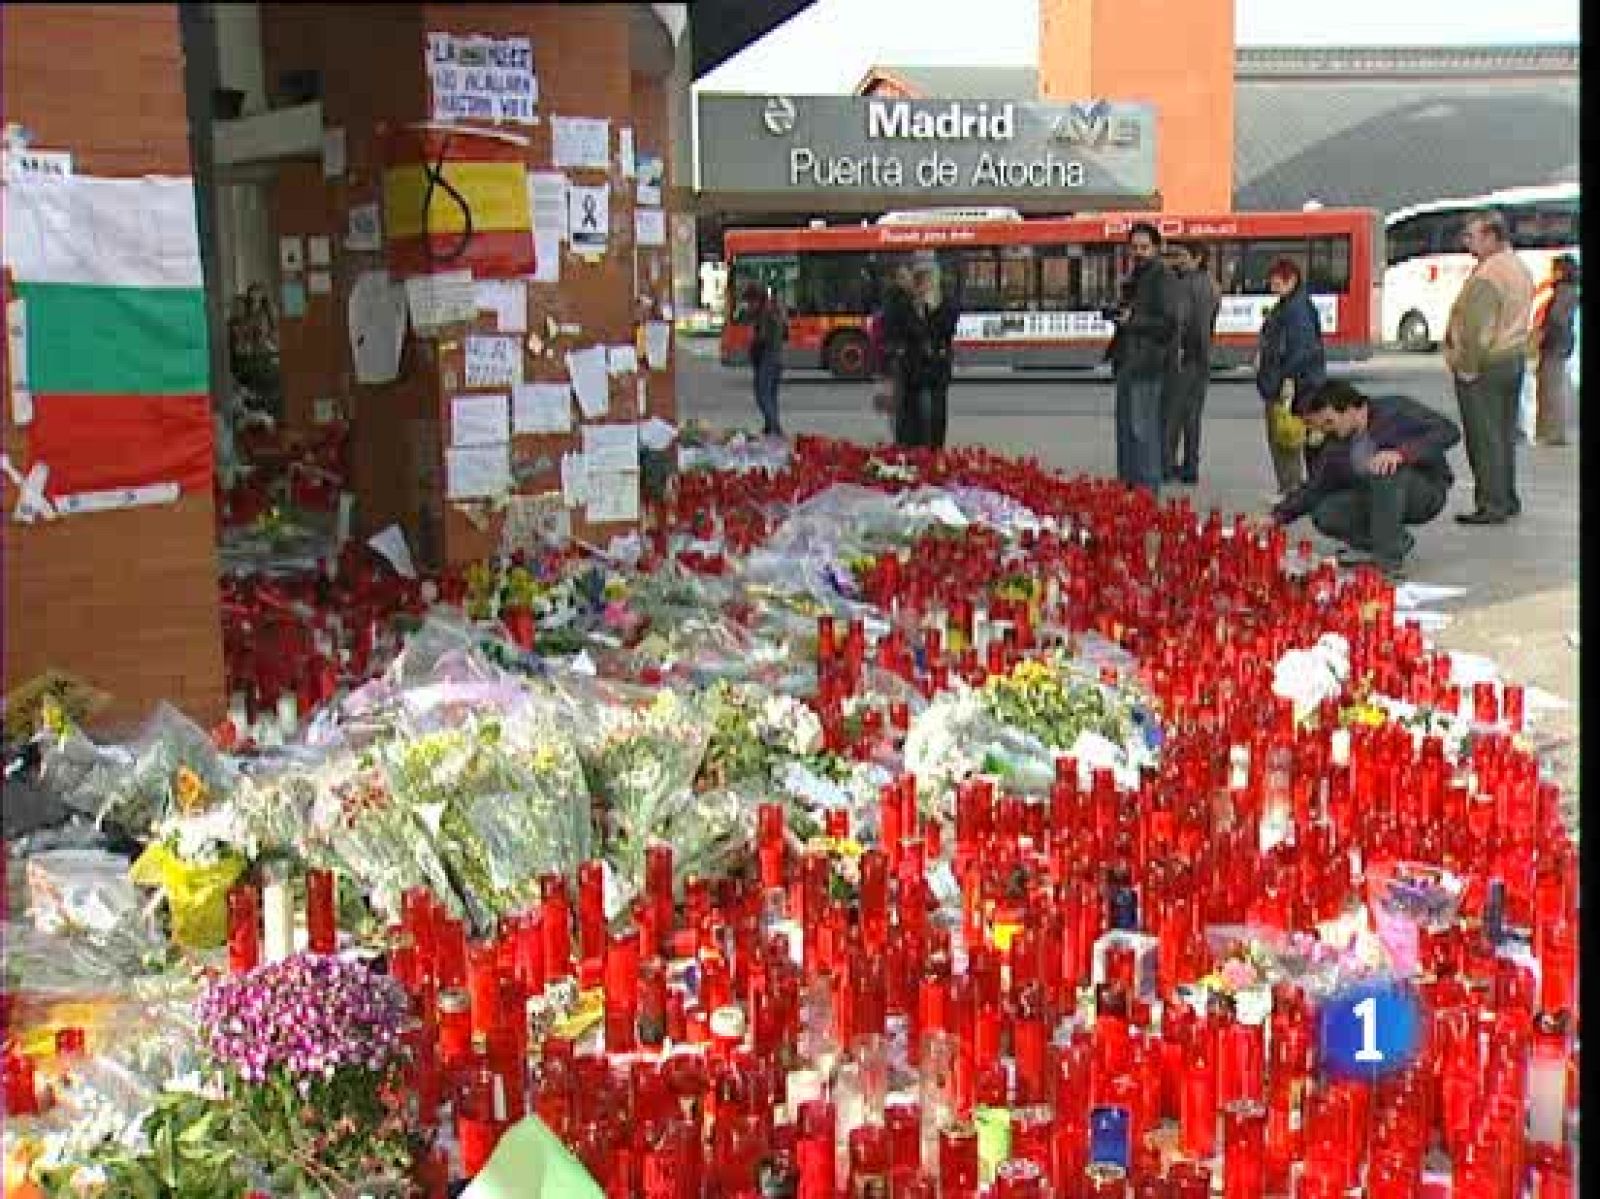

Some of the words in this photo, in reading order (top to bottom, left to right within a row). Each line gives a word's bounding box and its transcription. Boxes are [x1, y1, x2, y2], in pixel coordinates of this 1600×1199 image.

[868, 102, 1014, 139] Madrid
[1049, 113, 1138, 145] AVE
[790, 147, 903, 186] Puerta
[917, 150, 958, 187] de
[972, 150, 1085, 187] Atocha
